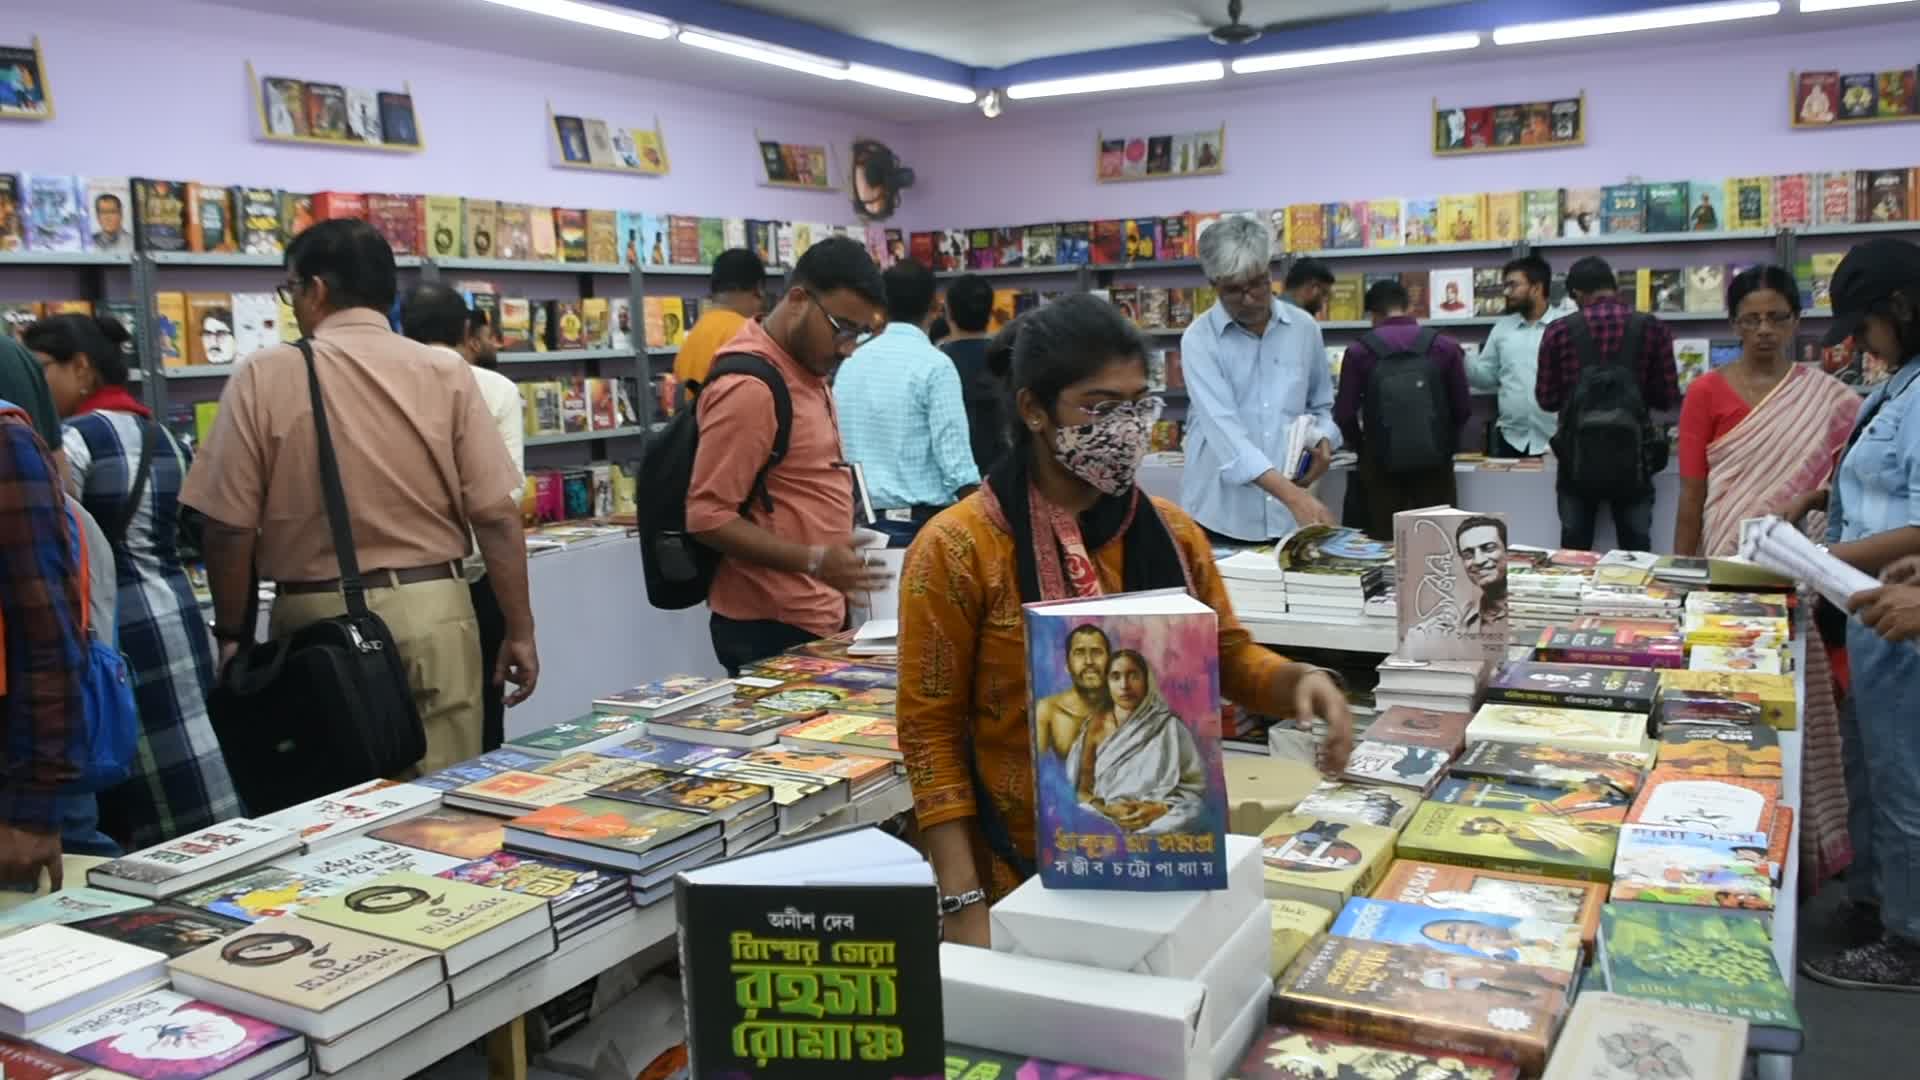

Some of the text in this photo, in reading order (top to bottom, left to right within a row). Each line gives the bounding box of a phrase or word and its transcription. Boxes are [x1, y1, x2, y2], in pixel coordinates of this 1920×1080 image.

[1055, 826, 1117, 858] ঠাকুর
[1156, 832, 1216, 854] সমগ্র
[1054, 856, 1214, 879] সঞ্জীব চট্টোপাধ্যায়
[767, 907, 855, 932] অনীশ দেব
[730, 931, 896, 968] বিশ্বের সেরা
[731, 965, 897, 1021] রহস্য
[731, 1019, 905, 1069] রোমাঞ্চ
